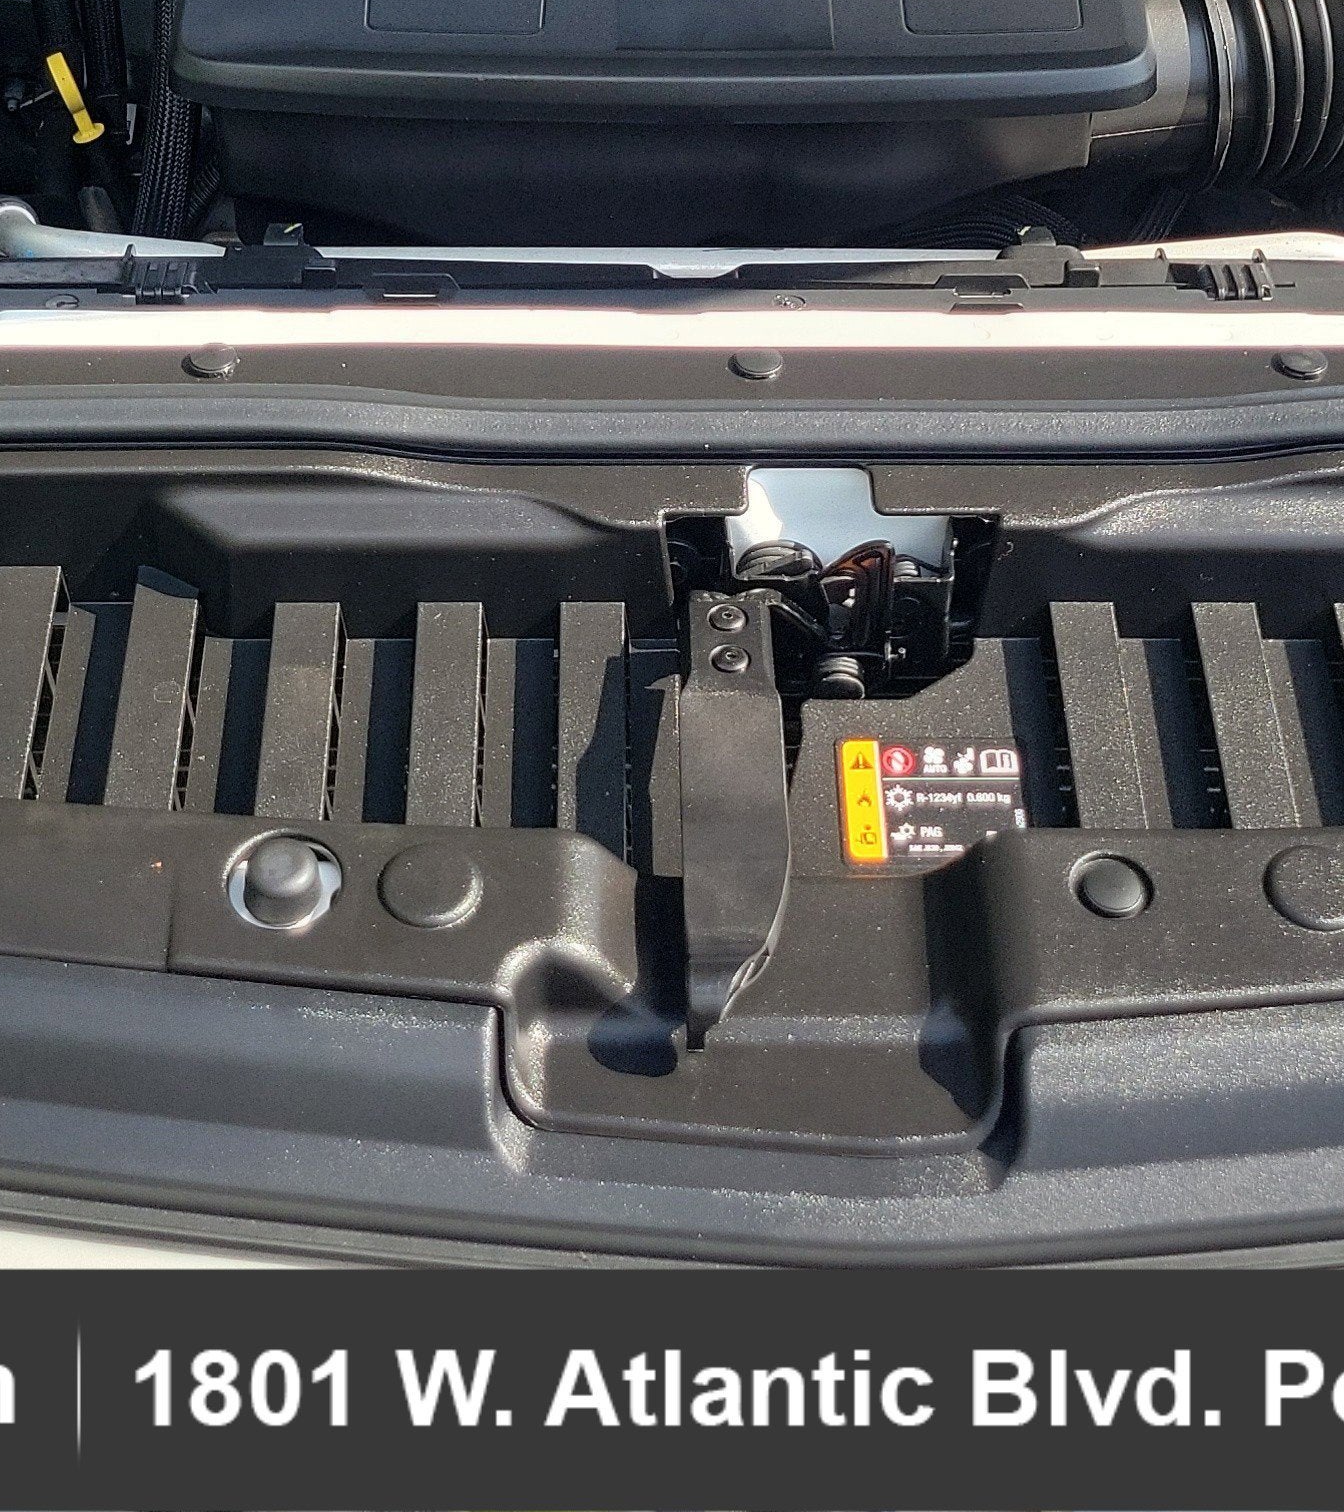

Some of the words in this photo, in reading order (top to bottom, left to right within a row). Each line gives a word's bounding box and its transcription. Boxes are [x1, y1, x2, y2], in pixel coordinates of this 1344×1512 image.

[923, 764, 948, 774] AUTO
[997, 792, 1011, 804] kg
[920, 826, 943, 838] PAG
